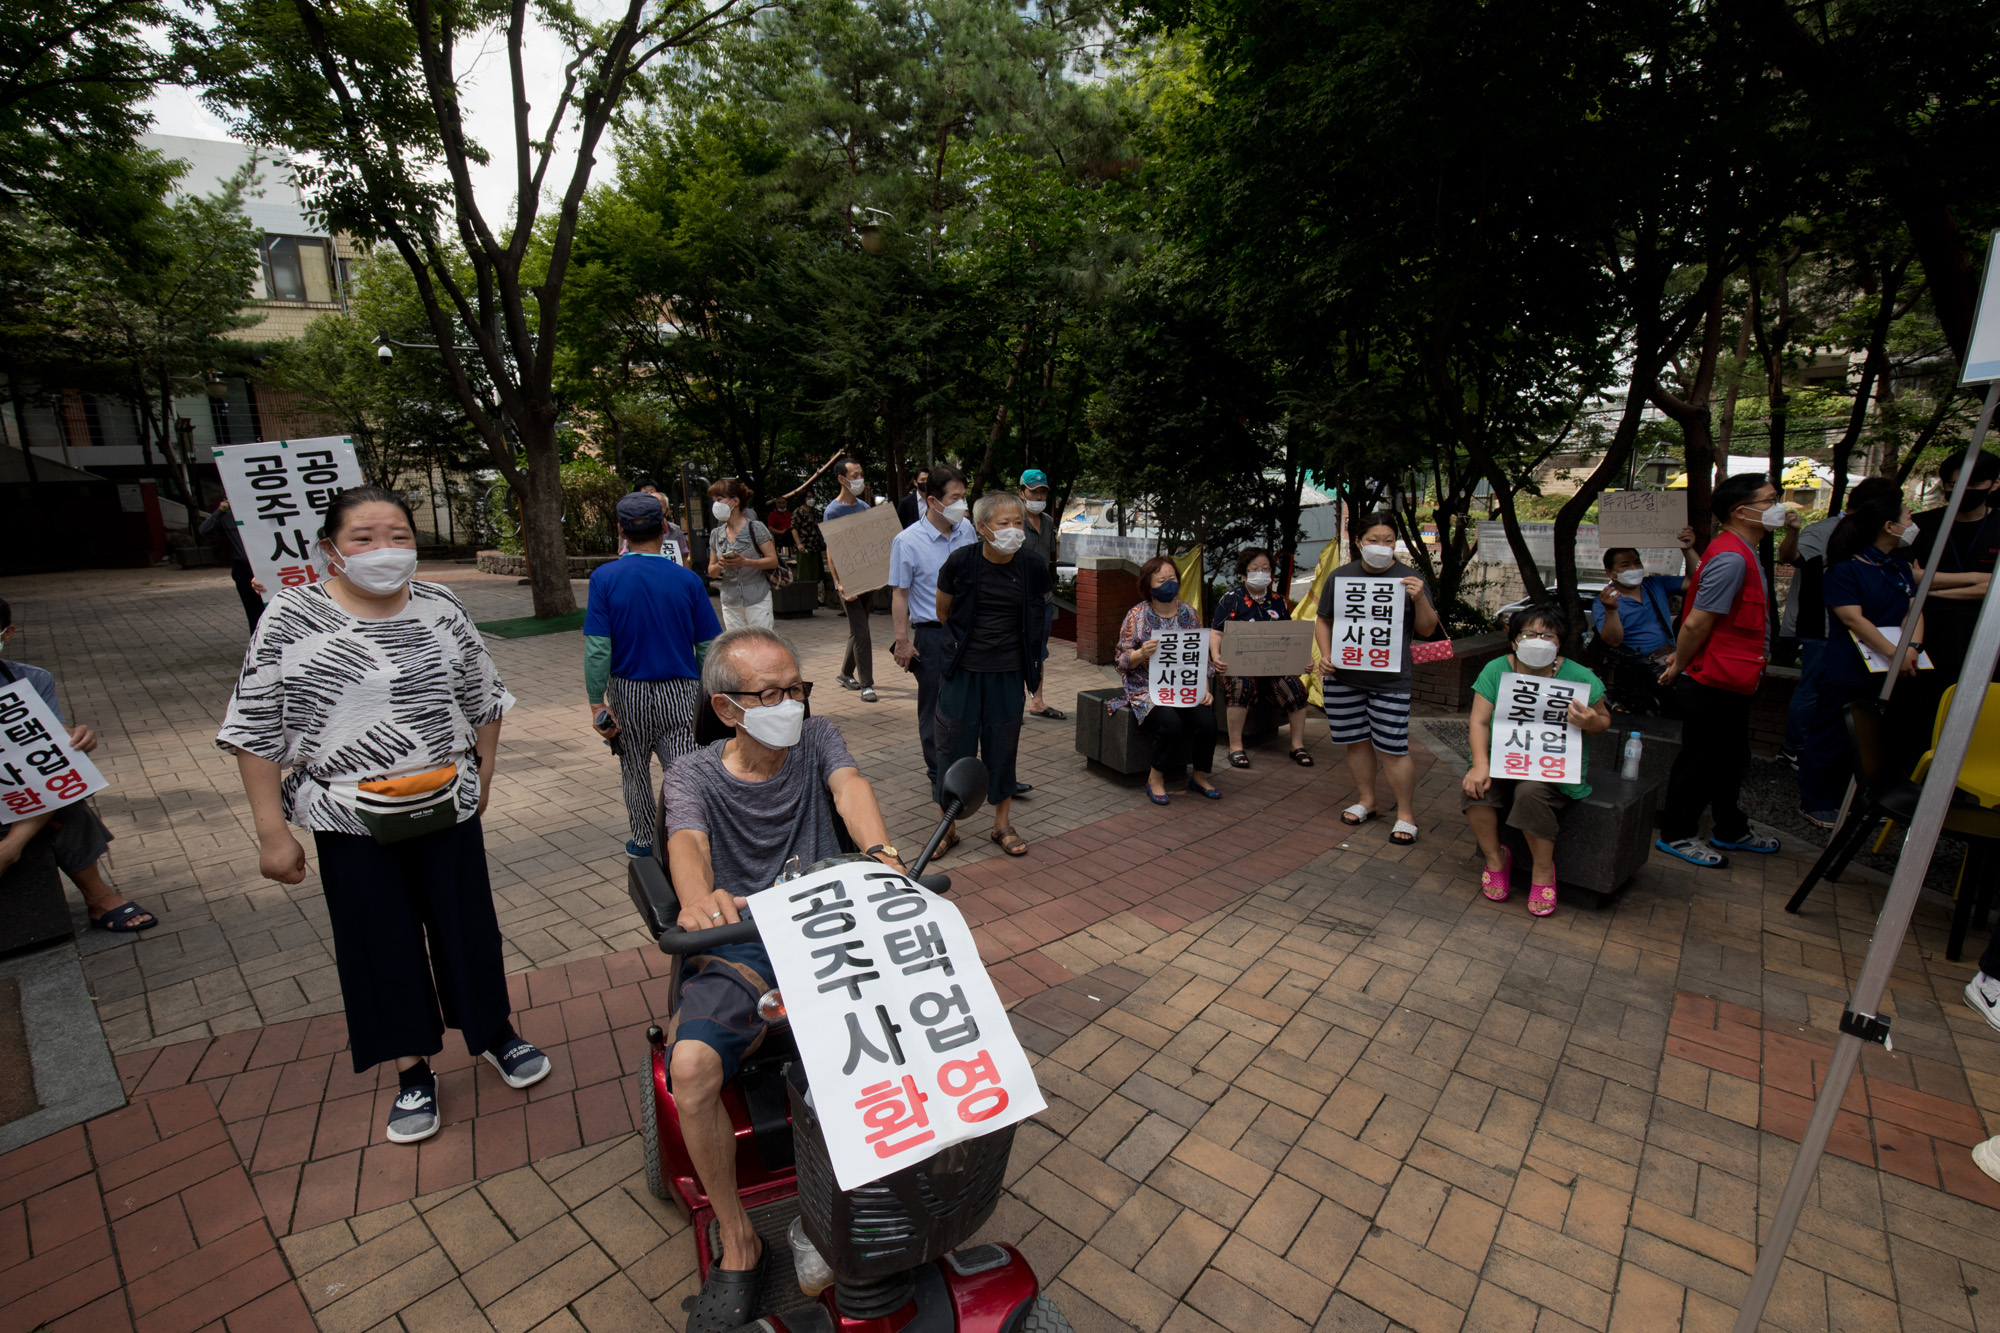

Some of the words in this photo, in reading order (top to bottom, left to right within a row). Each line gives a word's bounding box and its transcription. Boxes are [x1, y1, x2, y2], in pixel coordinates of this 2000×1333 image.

[244, 450, 338, 490] 공공
[1602, 492, 1656, 511] 투기근절
[270, 528, 310, 562] 사
[661, 543, 675, 555] 공
[1344, 582, 1395, 603] 공공
[1344, 604, 1393, 625] 주택
[1160, 632, 1201, 650] 공공
[1341, 625, 1391, 647] 사업
[1158, 651, 1200, 668] 주택
[1341, 646, 1390, 668] 환영
[1157, 669, 1198, 686] 사업
[1157, 687, 1197, 705] 환영
[1512, 679, 1575, 709] 공공
[0, 692, 30, 724] 공
[1507, 705, 1568, 731] 주택
[1504, 728, 1567, 754] 사업
[1503, 752, 1566, 779] 환영
[1, 768, 88, 815] 환영
[788, 872, 928, 940] 공공
[810, 921, 955, 1001] 주택
[842, 984, 981, 1076] 사업
[854, 1049, 1009, 1159] 환영
